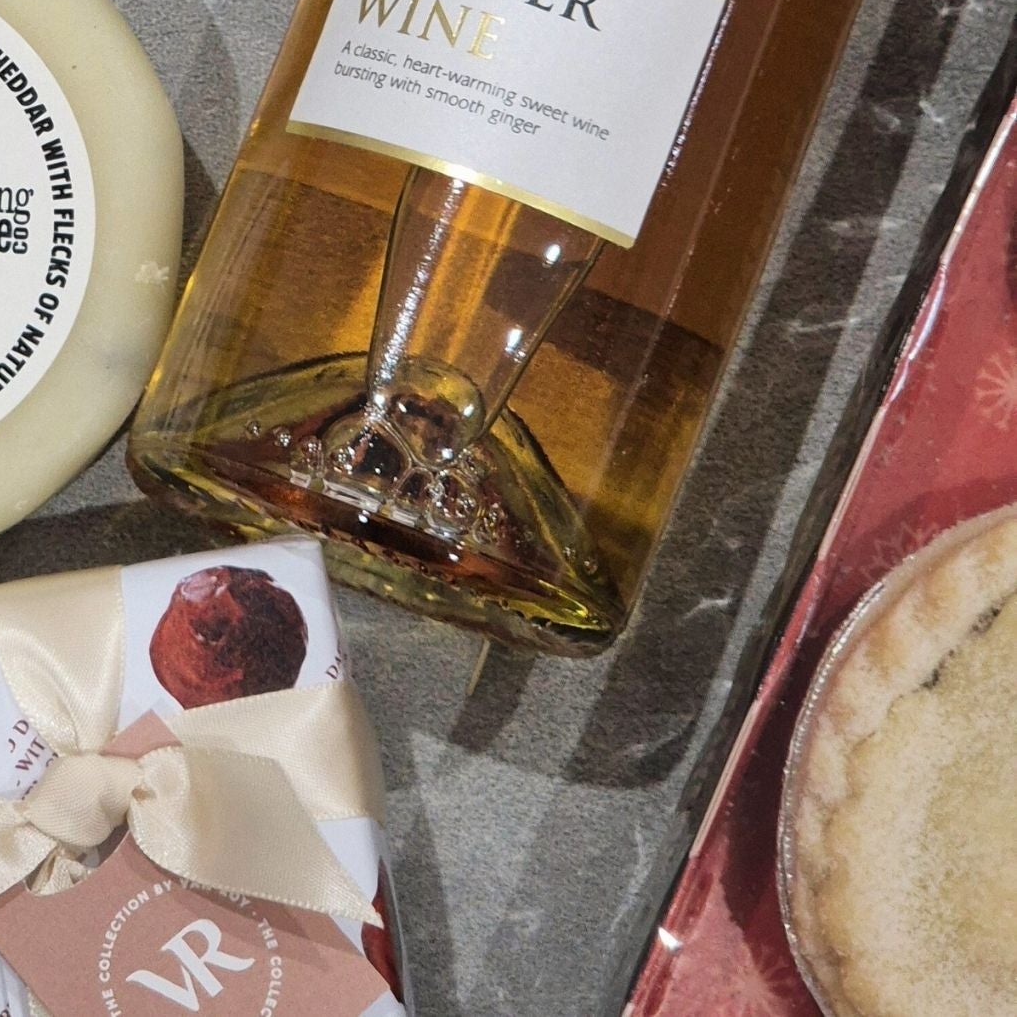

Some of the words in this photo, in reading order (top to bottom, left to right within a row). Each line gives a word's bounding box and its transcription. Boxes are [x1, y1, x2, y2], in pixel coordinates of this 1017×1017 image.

[333, 61, 387, 89] bursting
[389, 75, 422, 95] with
[425, 86, 486, 116] smooth
[490, 107, 542, 136] ginger
[341, 40, 352, 55] A
[353, 43, 398, 67] classic,
[402, 54, 518, 107] heart-warming
[520, 94, 569, 124] sweet
[572, 114, 610, 142] wine
[40, 138, 74, 202] WITH
[46, 208, 75, 290] FLECKS
[28, 293, 60, 327] OF
[99, 889, 150, 983] COLLECTION
[153, 880, 173, 897] BY
[257, 917, 279, 951] THE
[125, 918, 256, 1012] VR
